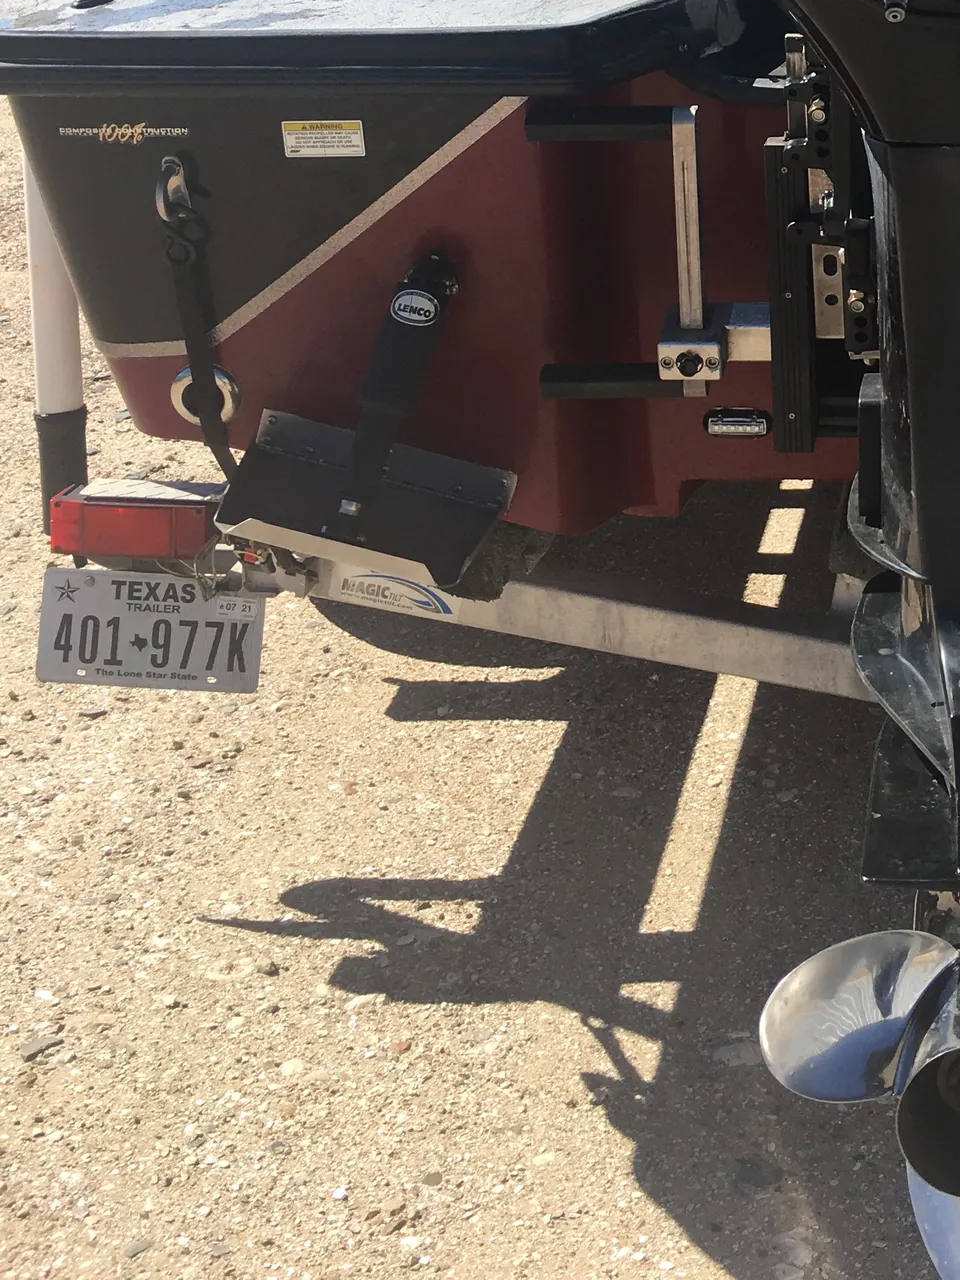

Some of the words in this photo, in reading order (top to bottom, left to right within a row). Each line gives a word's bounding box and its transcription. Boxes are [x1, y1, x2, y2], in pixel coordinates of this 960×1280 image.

[397, 303, 432, 318] LENCO
[111, 579, 197, 604] TEXAS
[341, 578, 390, 599] MAGIC
[127, 602, 181, 614] TRAILER
[53, 613, 123, 666] 401
[150, 618, 250, 673] 977K
[95, 668, 114, 676] The
[117, 669, 142, 678] Lone
[145, 671, 167, 679] Star
[170, 672, 198, 680] State
